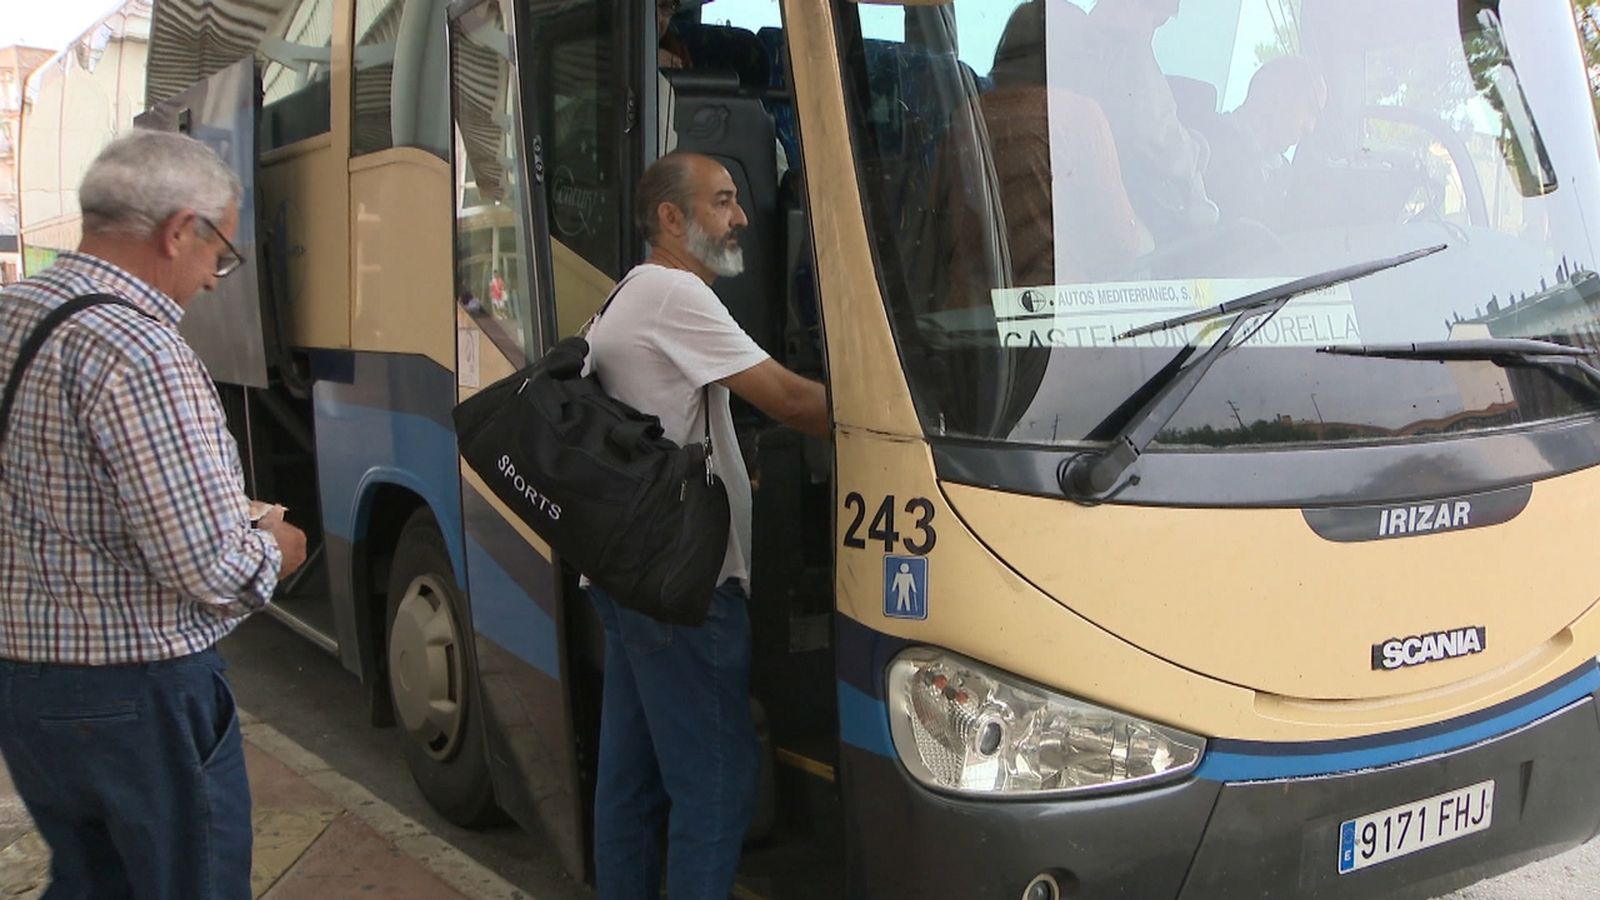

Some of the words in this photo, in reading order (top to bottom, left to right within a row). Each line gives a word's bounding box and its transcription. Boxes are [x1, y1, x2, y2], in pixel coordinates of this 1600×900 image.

[1058, 290, 1095, 307] AUTOS
[497, 454, 563, 520] SPORTS
[843, 491, 937, 556] 243
[1378, 501, 1472, 537] IRIZAR
[1381, 627, 1482, 670] SCANIA
[1344, 849, 1352, 861] E
[1361, 806, 1426, 860] 9171
[1438, 788, 1487, 837] FHJ
